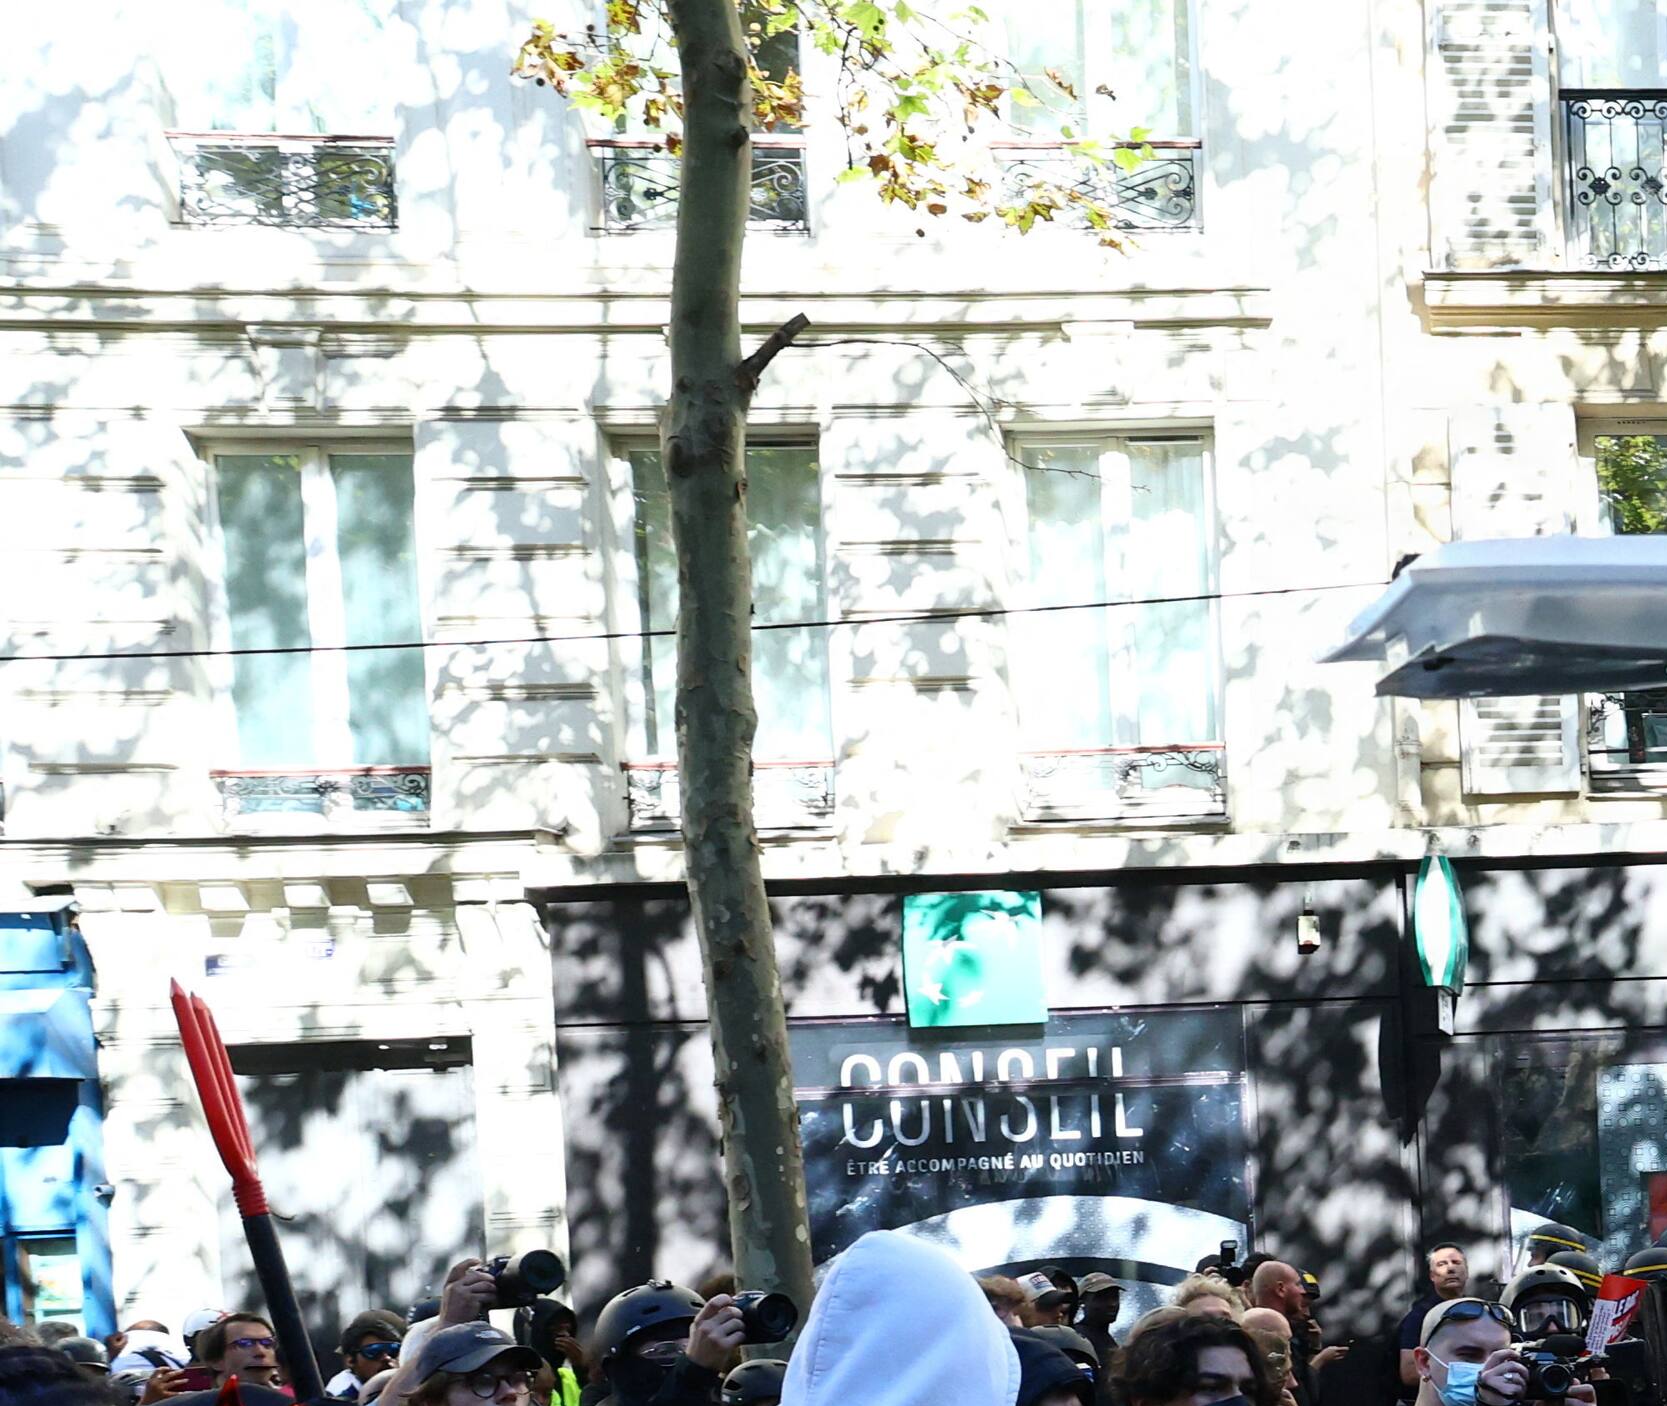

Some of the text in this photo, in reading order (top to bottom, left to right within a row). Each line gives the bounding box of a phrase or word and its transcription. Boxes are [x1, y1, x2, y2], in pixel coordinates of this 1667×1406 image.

[840, 1047, 1144, 1149] CONSEIL
[846, 1150, 1144, 1176] ÊTRE ACCOMPAGNÉ AU QUOTIDIEN
